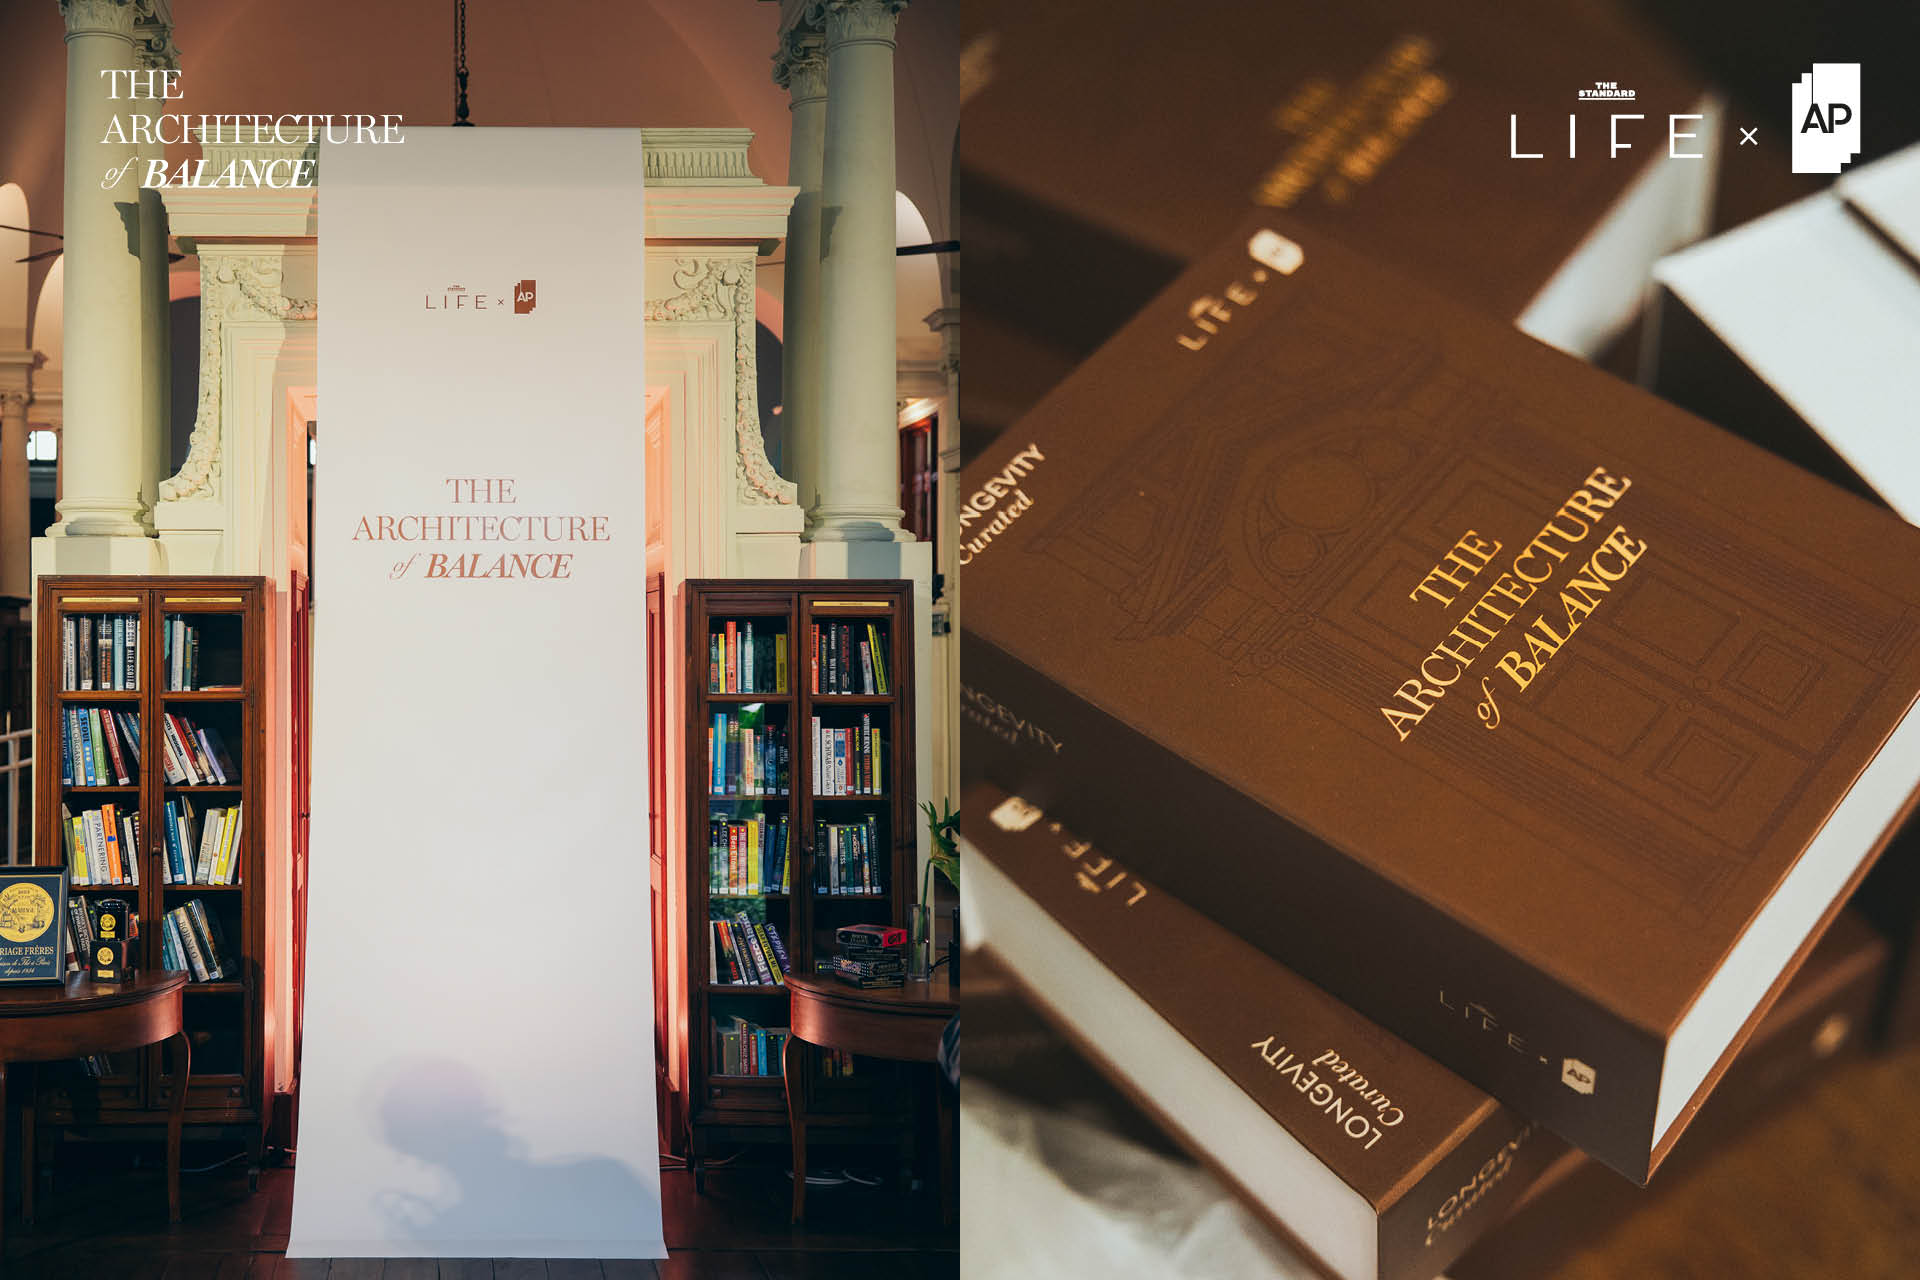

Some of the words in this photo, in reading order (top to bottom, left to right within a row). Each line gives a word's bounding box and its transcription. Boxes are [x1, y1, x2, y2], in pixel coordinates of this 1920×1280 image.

[425, 295, 488, 309] LIFE
[517, 291, 534, 302] AP
[445, 478, 517, 503] THE
[960, 443, 1045, 537] NGEVITY
[352, 515, 610, 541] ARCHITECTURE
[389, 552, 422, 580] of
[424, 553, 573, 578] BALANCE
[1409, 529, 1503, 608] THE
[1380, 466, 1632, 742] ARCHITECTURE
[1477, 676, 1502, 730] of
[1495, 525, 1648, 693] BALANCE
[80, 716, 90, 742] SEOUL
[94, 822, 108, 873] PARTNERING
[0, 947, 24, 956] RIAGE
[179, 921, 199, 959] BORNEO
[1440, 991, 1525, 1054] LIFE
[1251, 1036, 1382, 1149] LONGEVITY
[1311, 1049, 1404, 1126] Curated
